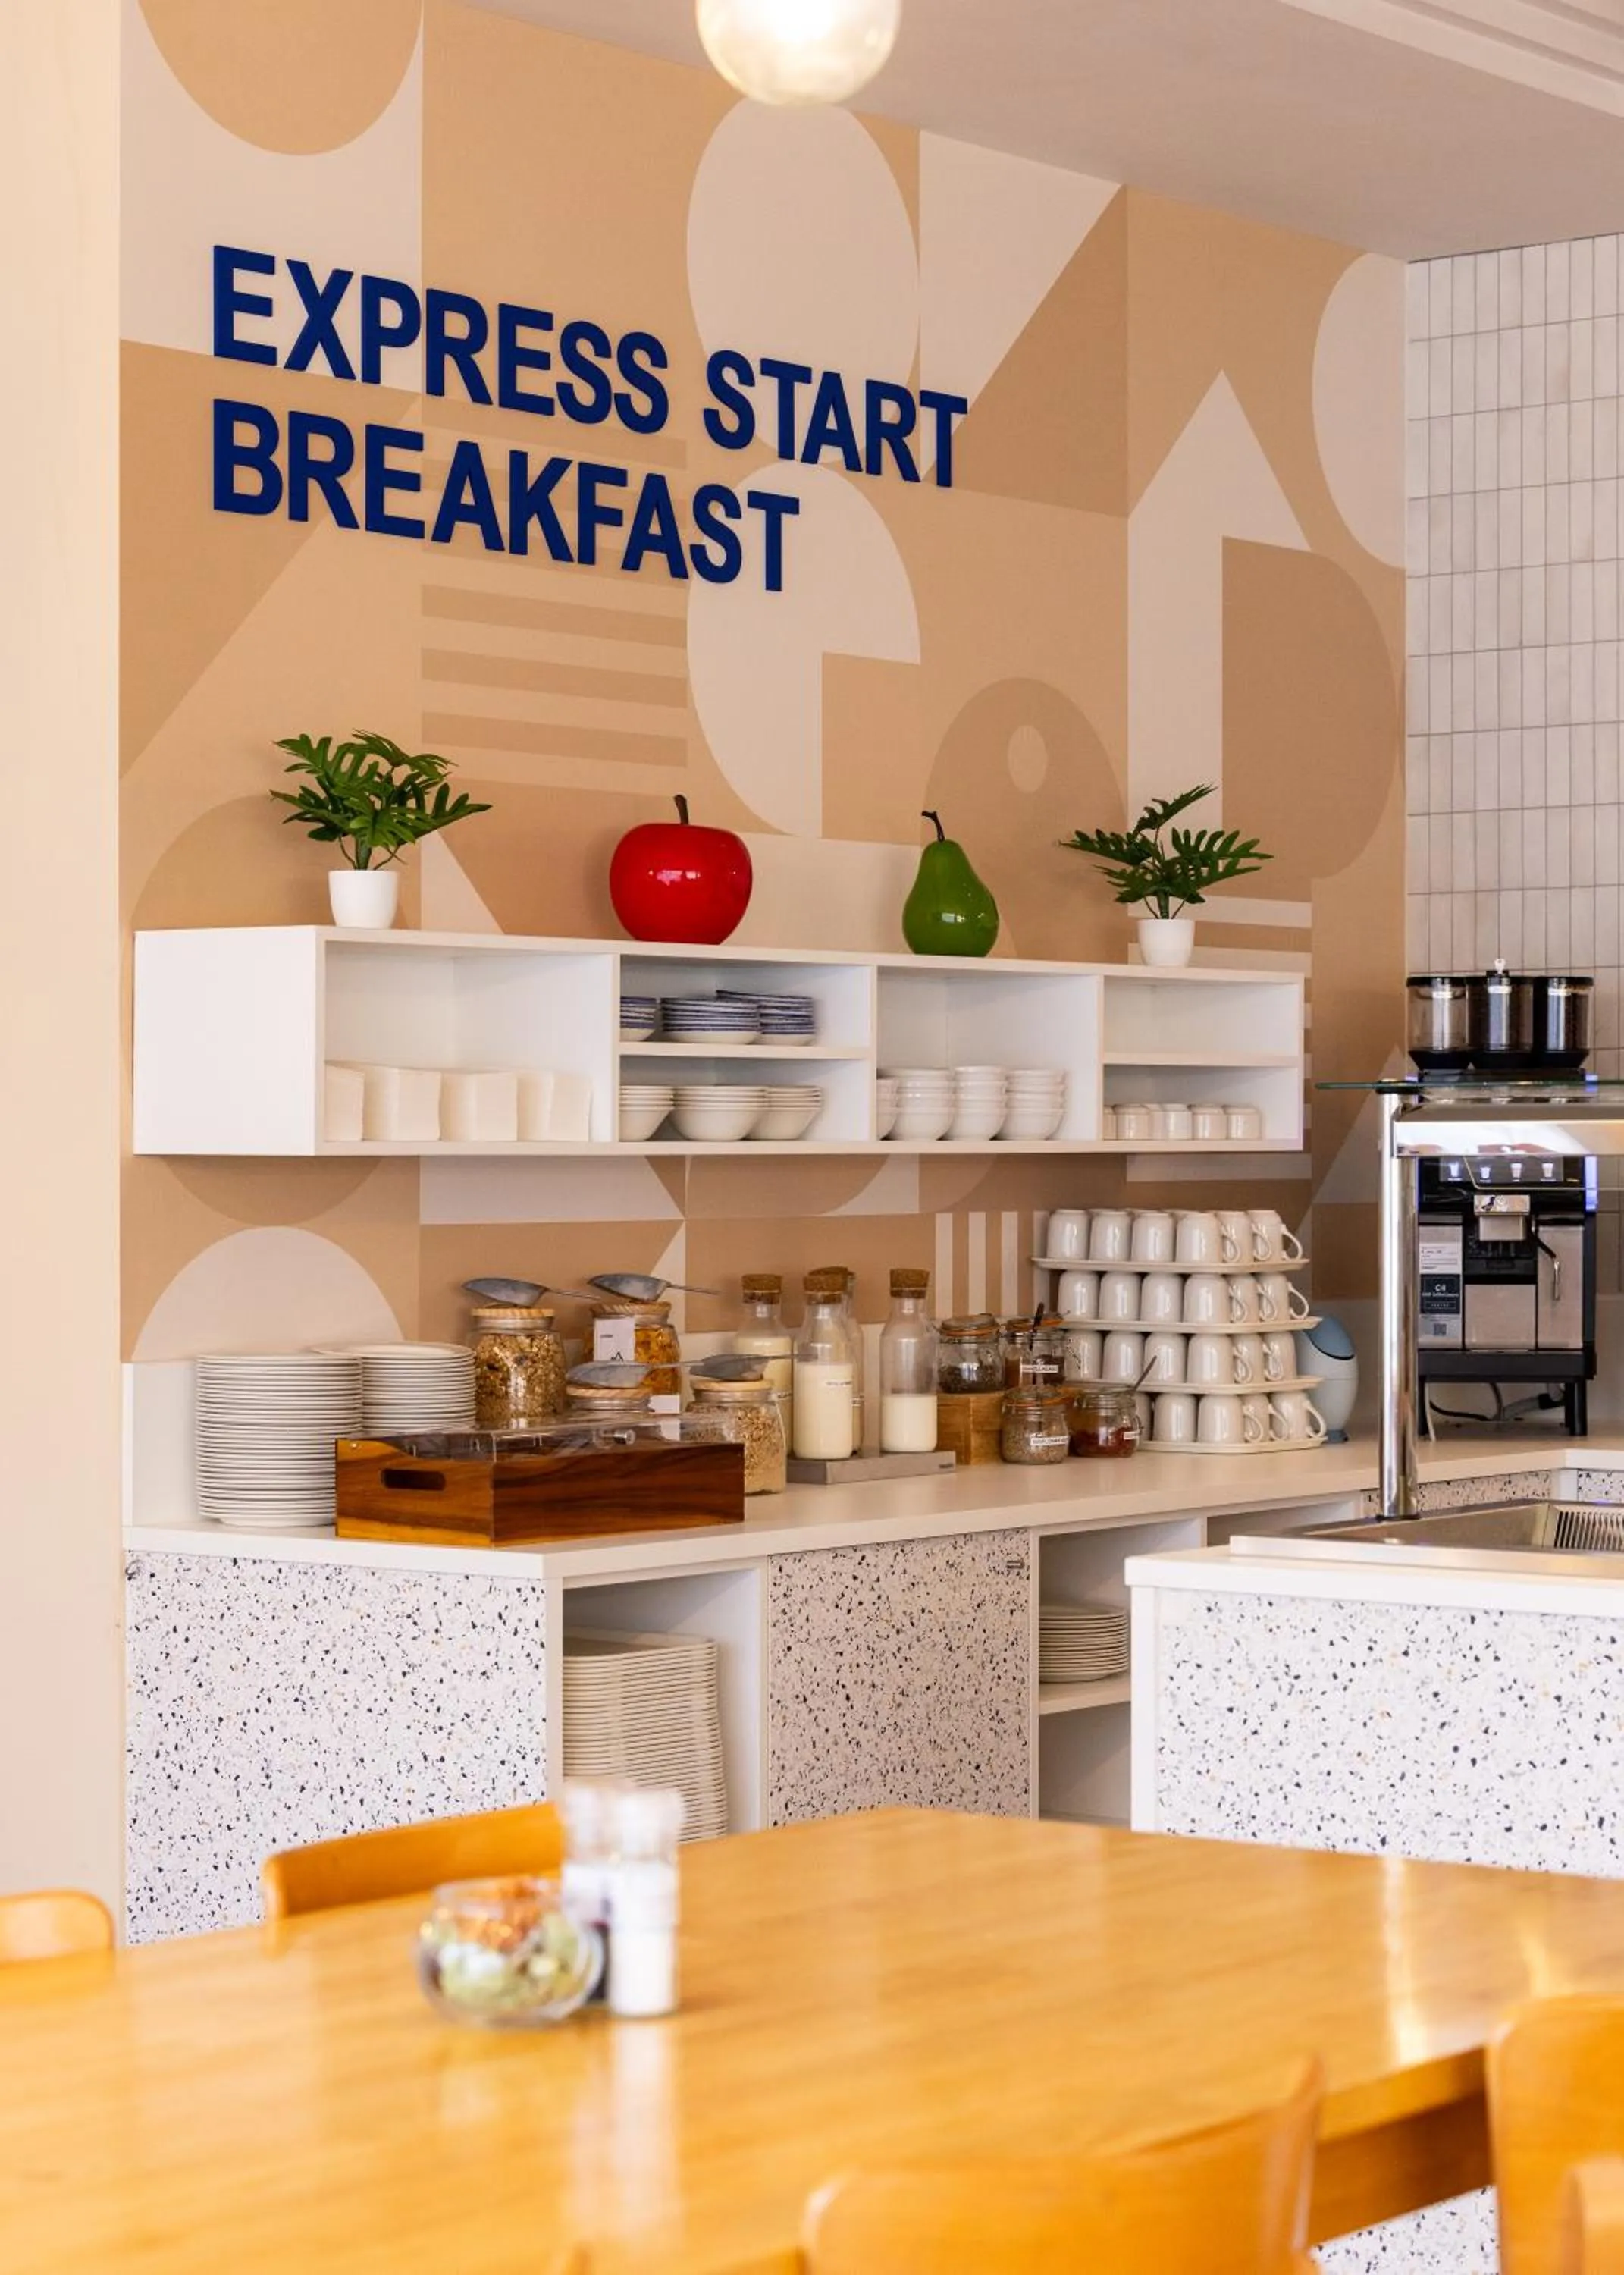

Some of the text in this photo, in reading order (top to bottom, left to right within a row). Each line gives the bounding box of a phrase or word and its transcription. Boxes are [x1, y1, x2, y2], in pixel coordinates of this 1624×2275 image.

[212, 246, 967, 488] EXPRESS START
[212, 399, 800, 592] BREAKFAST
